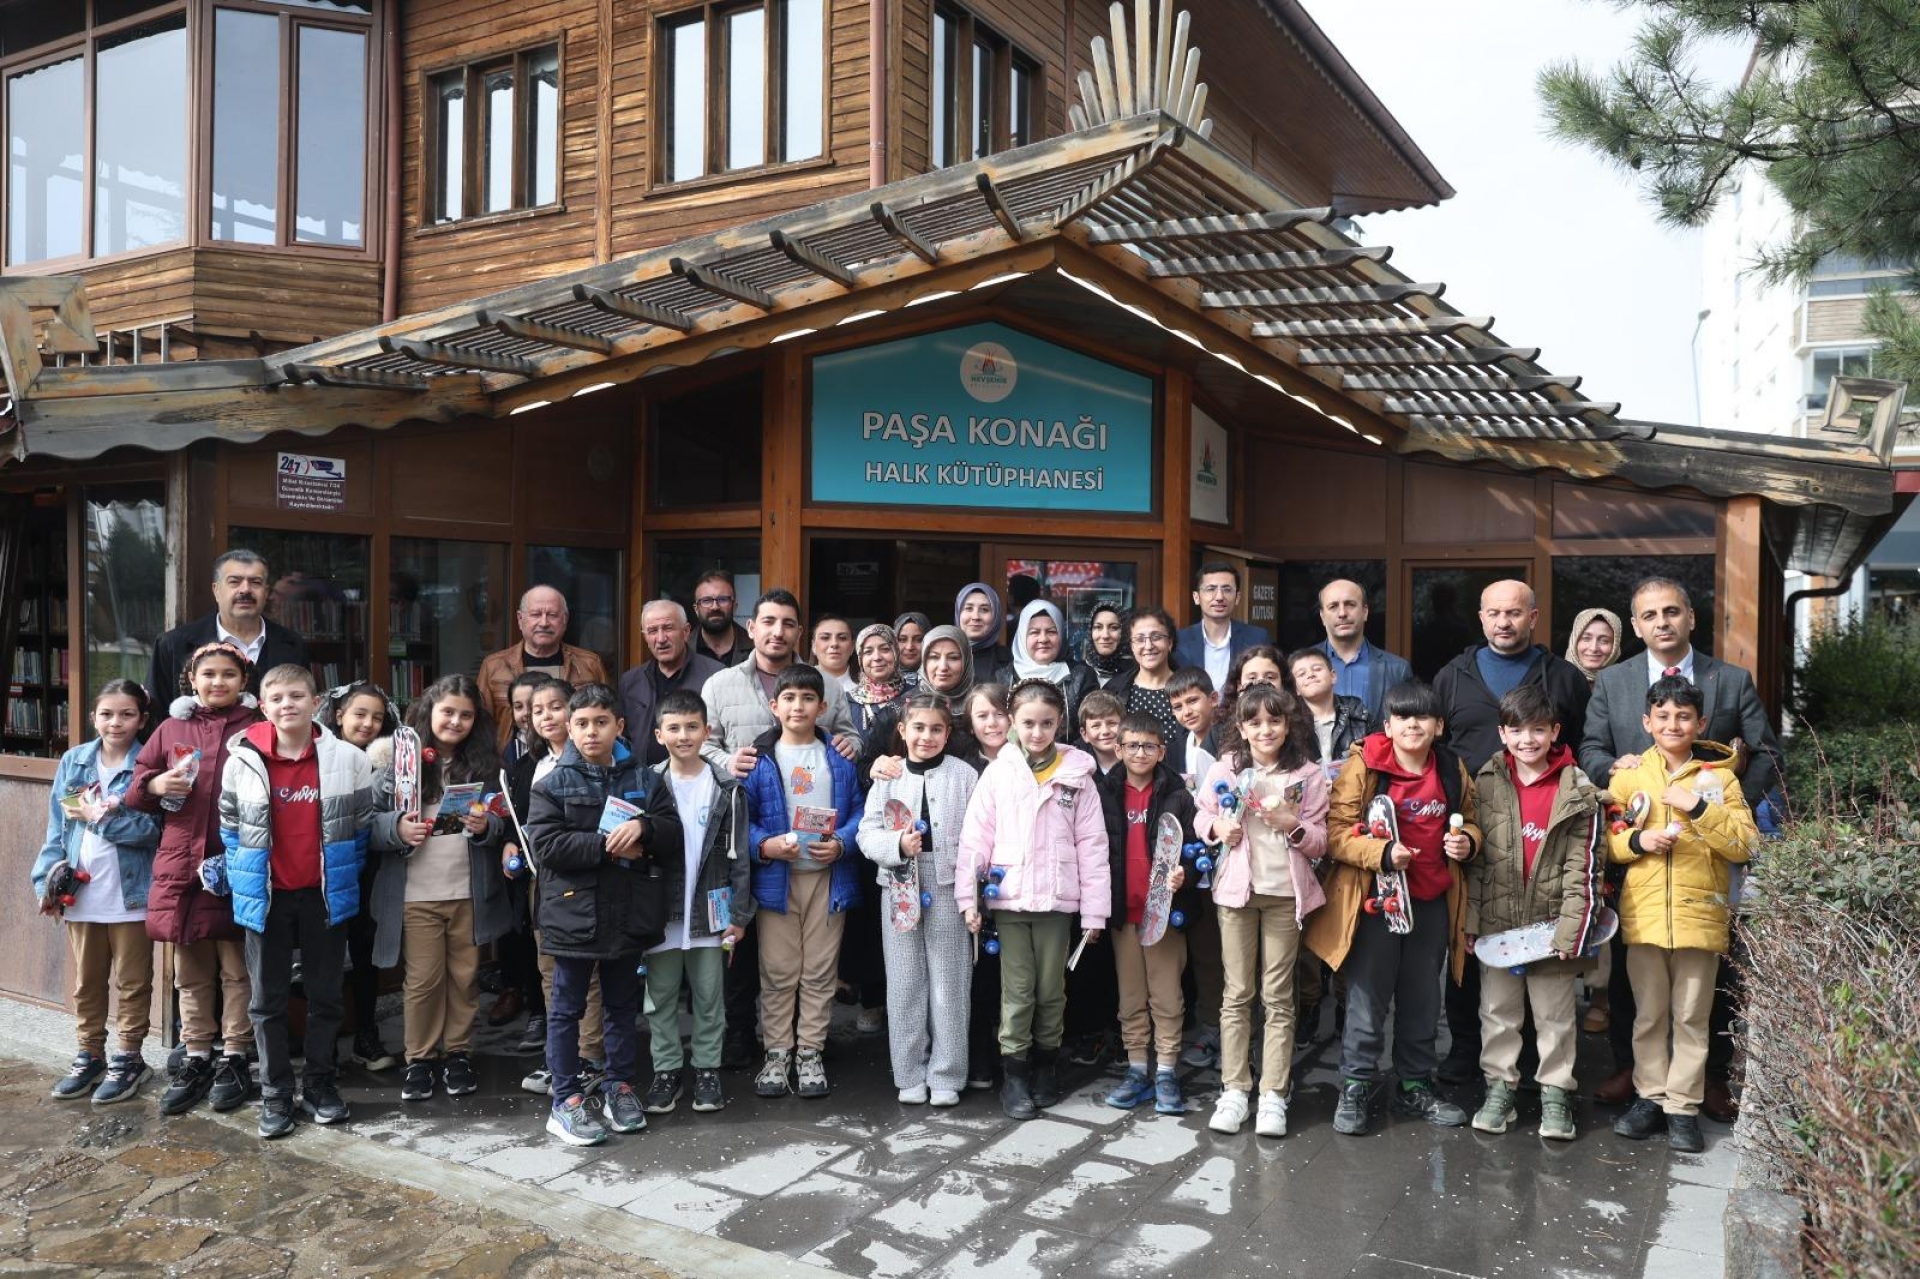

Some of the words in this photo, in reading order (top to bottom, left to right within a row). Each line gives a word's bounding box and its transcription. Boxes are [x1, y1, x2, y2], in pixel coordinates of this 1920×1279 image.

[862, 411, 956, 449] PAŞA
[968, 415, 1108, 451] KONAĞI
[864, 461, 930, 484] HALK
[937, 460, 1104, 491] KÜTÜPHANESİ
[1253, 584, 1274, 600] GAZETE
